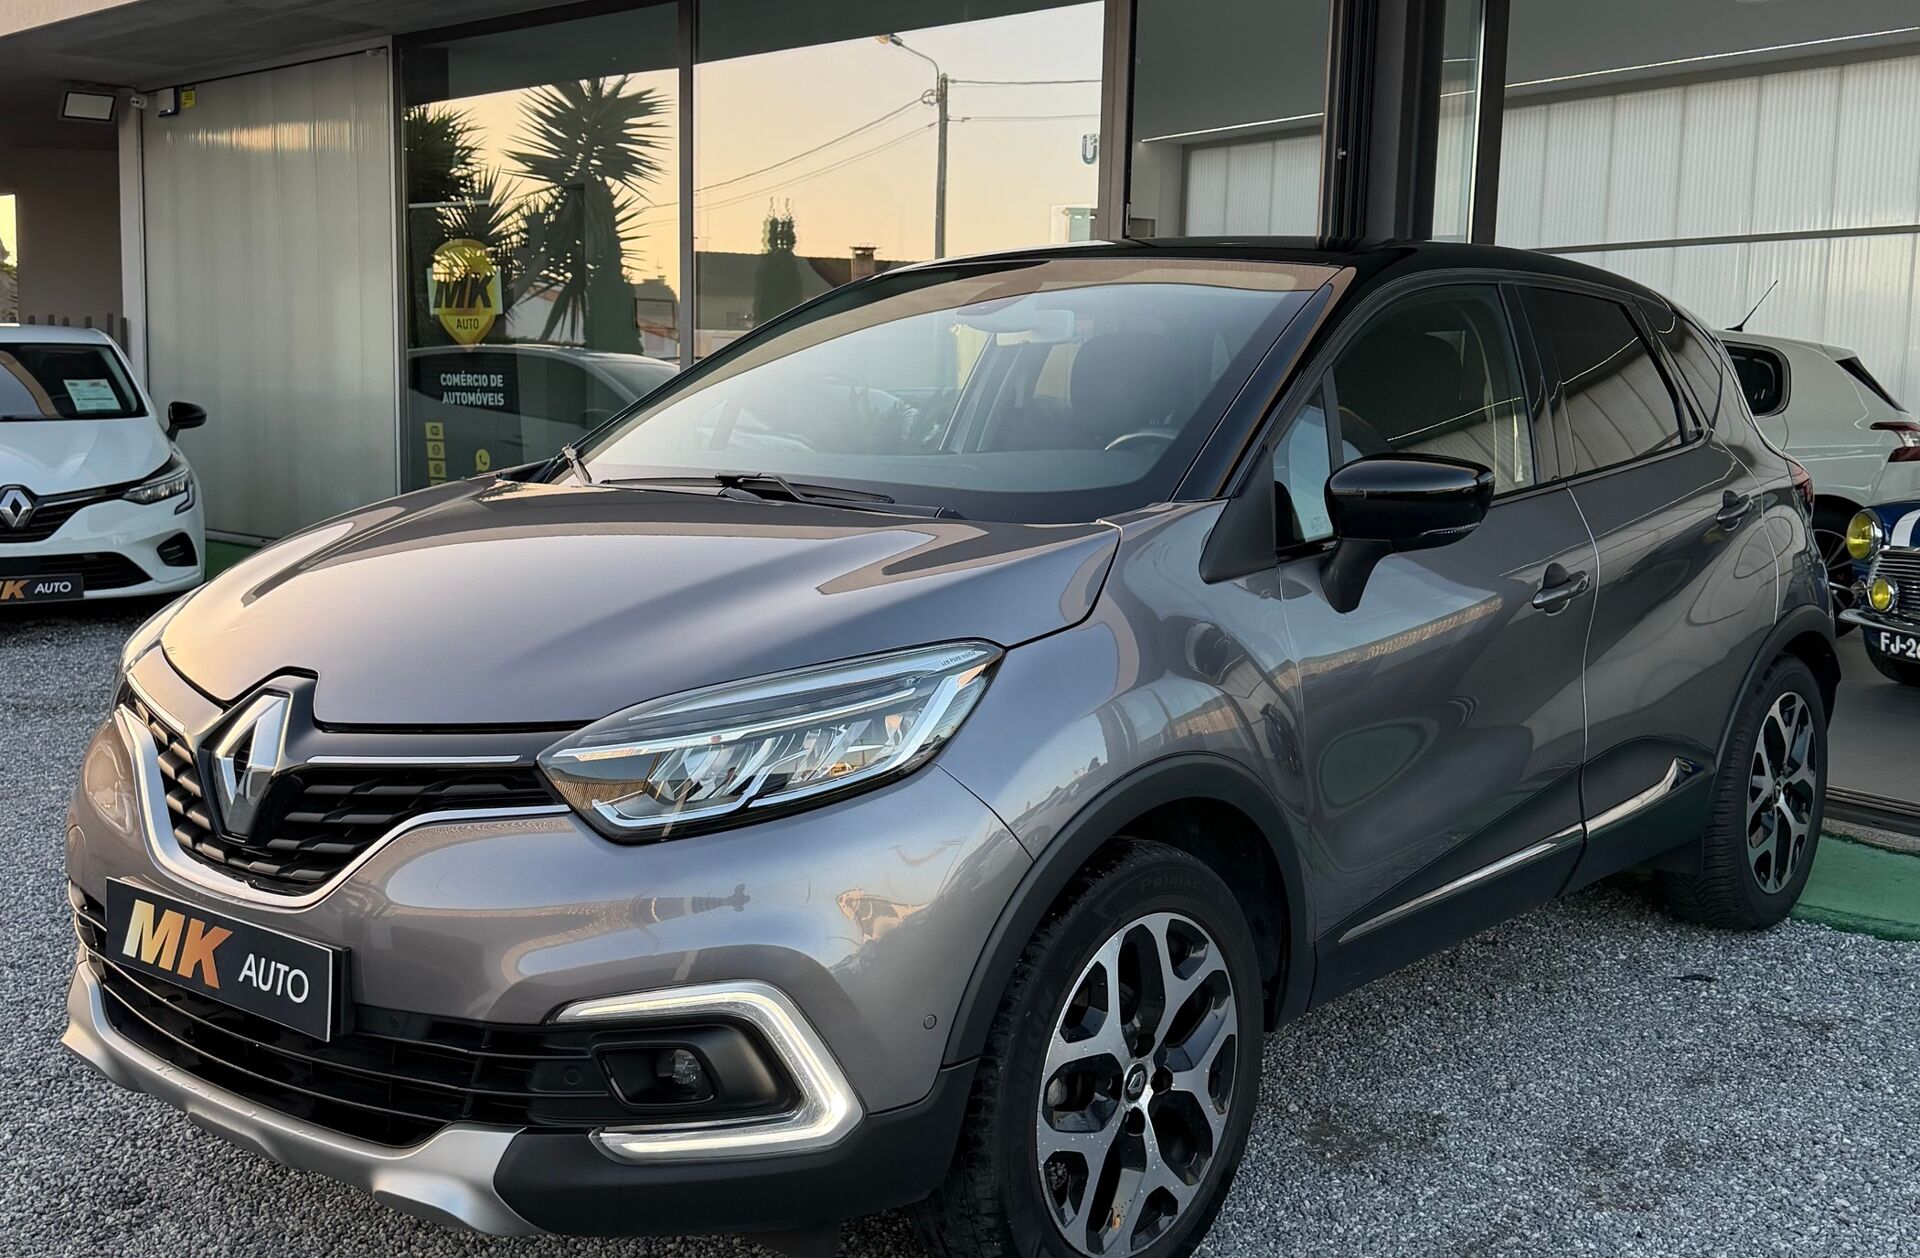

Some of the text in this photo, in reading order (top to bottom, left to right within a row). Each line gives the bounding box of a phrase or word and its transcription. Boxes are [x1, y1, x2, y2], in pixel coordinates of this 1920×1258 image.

[434, 273, 494, 309] MK
[456, 318, 479, 330] AUTO
[440, 370, 504, 387] COMÉRCIO DE
[442, 389, 504, 406] AUTOMÓVEIS
[0, 579, 72, 600] K AUTO
[122, 899, 309, 1003] MK AUTO
